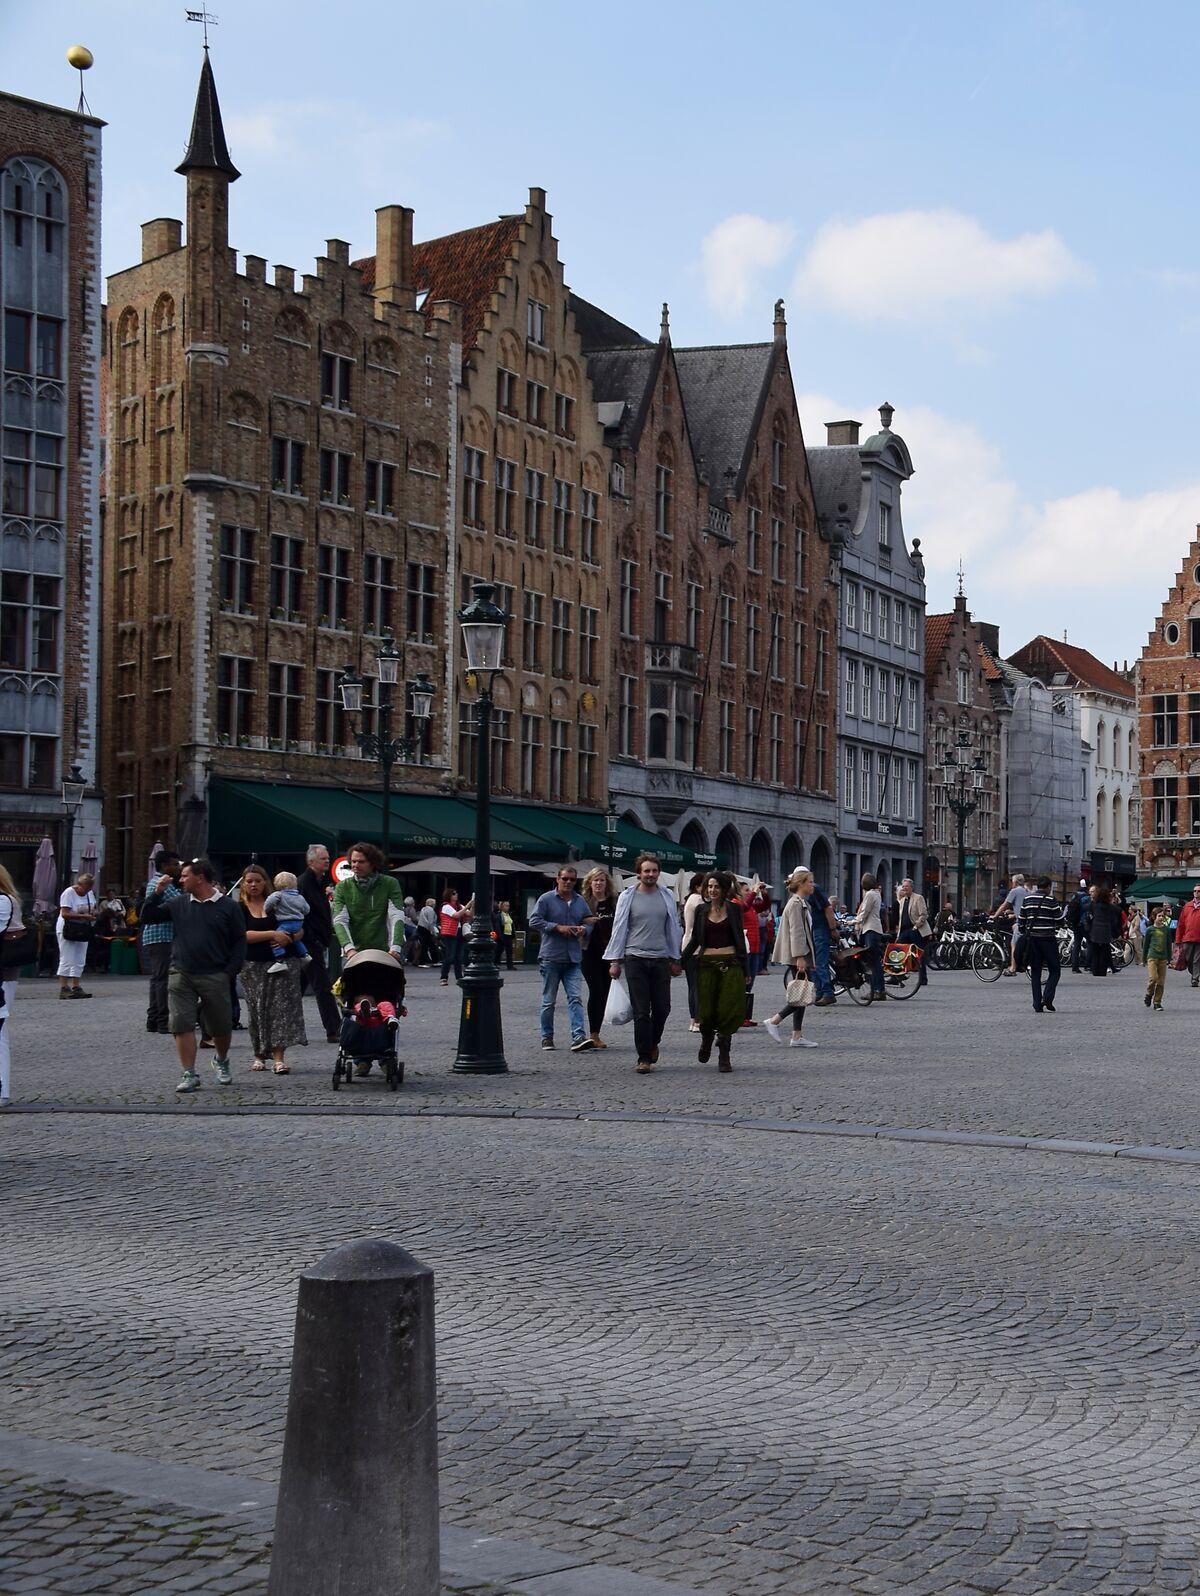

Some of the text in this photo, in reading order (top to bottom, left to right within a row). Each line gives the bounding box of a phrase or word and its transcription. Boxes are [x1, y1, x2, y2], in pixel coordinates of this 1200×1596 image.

[878, 822, 890, 833] fnac
[413, 835, 514, 851] GRAND CAFE CRANBURG
[1169, 840, 1183, 849] DE
